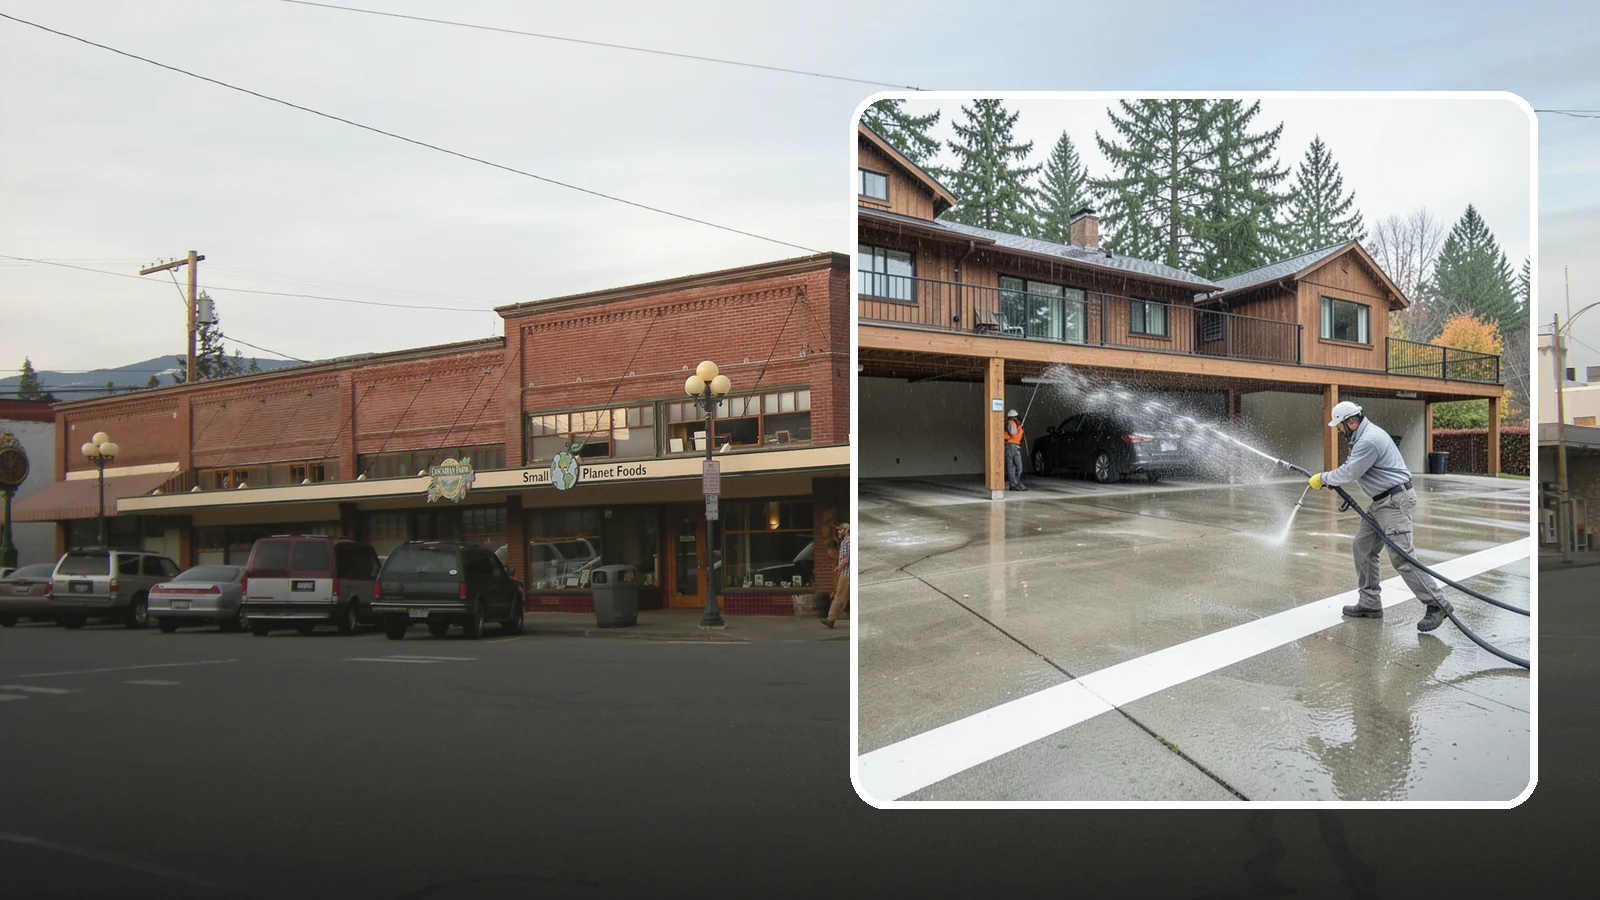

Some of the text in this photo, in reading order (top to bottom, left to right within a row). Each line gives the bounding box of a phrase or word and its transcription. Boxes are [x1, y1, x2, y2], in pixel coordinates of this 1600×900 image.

[523, 464, 647, 483] Small Planet Foods
